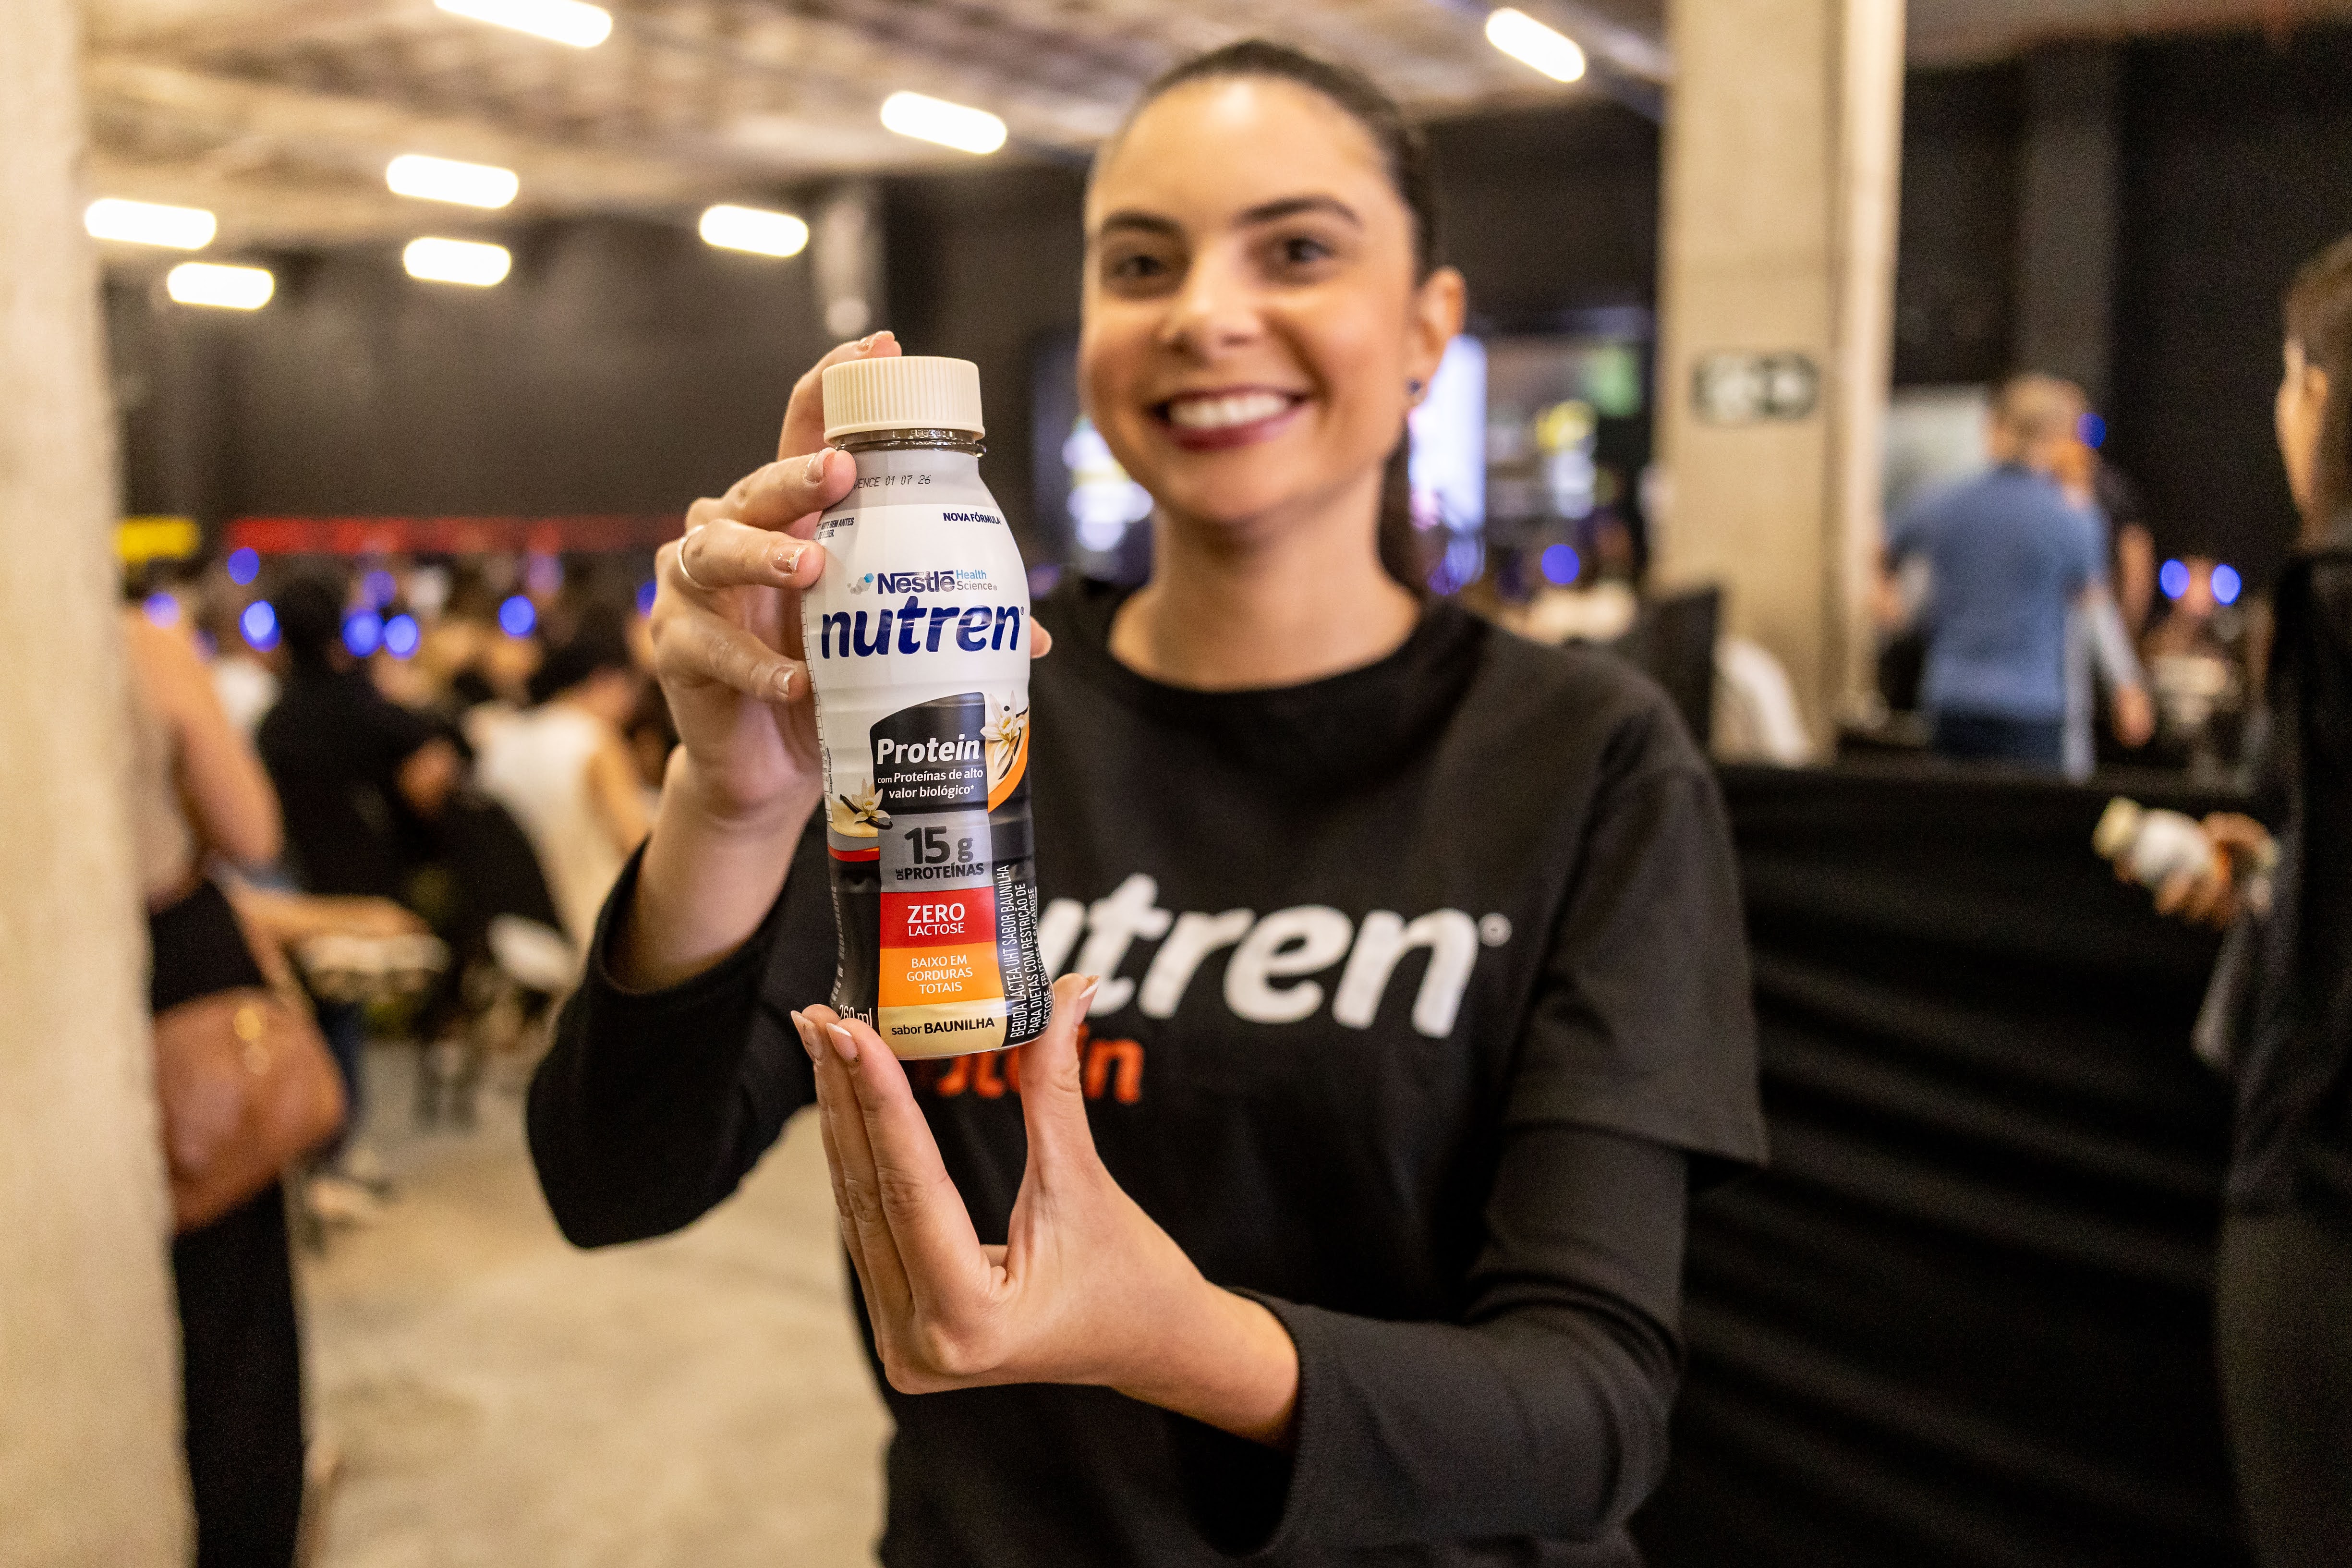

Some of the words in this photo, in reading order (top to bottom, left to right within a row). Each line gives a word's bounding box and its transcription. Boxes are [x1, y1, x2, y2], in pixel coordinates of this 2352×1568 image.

[885, 475, 895, 486] 01
[900, 475, 913, 485] 07
[918, 474, 931, 485] 26
[838, 517, 855, 527] ANTES
[943, 512, 970, 522] NOVA
[877, 570, 955, 595] Nestlé
[956, 570, 987, 580] Health
[877, 734, 980, 765] Protein
[894, 770, 946, 783] Proteínas
[948, 768, 962, 779] de
[964, 767, 983, 779] alto
[888, 787, 918, 798] valor
[904, 826, 951, 864] 15
[957, 837, 974, 863] g
[896, 868, 904, 880] DE
[904, 862, 984, 880] PROTEÍNAS
[996, 865, 1015, 912] BAUNILHA
[1015, 883, 1026, 897] DE
[907, 903, 965, 924] ZERO
[908, 922, 965, 936] LACTOSE
[1001, 913, 1018, 945] SABOR
[1015, 898, 1033, 949] RESTRIÇÃO
[911, 956, 947, 968] BAIXO
[950, 954, 967, 966] EM
[1003, 948, 1020, 967] UHT
[1022, 950, 1037, 973] COM
[907, 967, 973, 981] GORDURAS
[919, 982, 963, 994] TOTAIS
[1005, 967, 1027, 1002] LÁCTEA
[1026, 973, 1042, 1009] DIETAS
[857, 1008, 873, 1028] ml
[891, 1025, 922, 1035] sabor
[924, 1017, 995, 1033] BAUNILHA
[1010, 1002, 1028, 1038] BEBIDA
[1027, 1008, 1043, 1034] PARA
